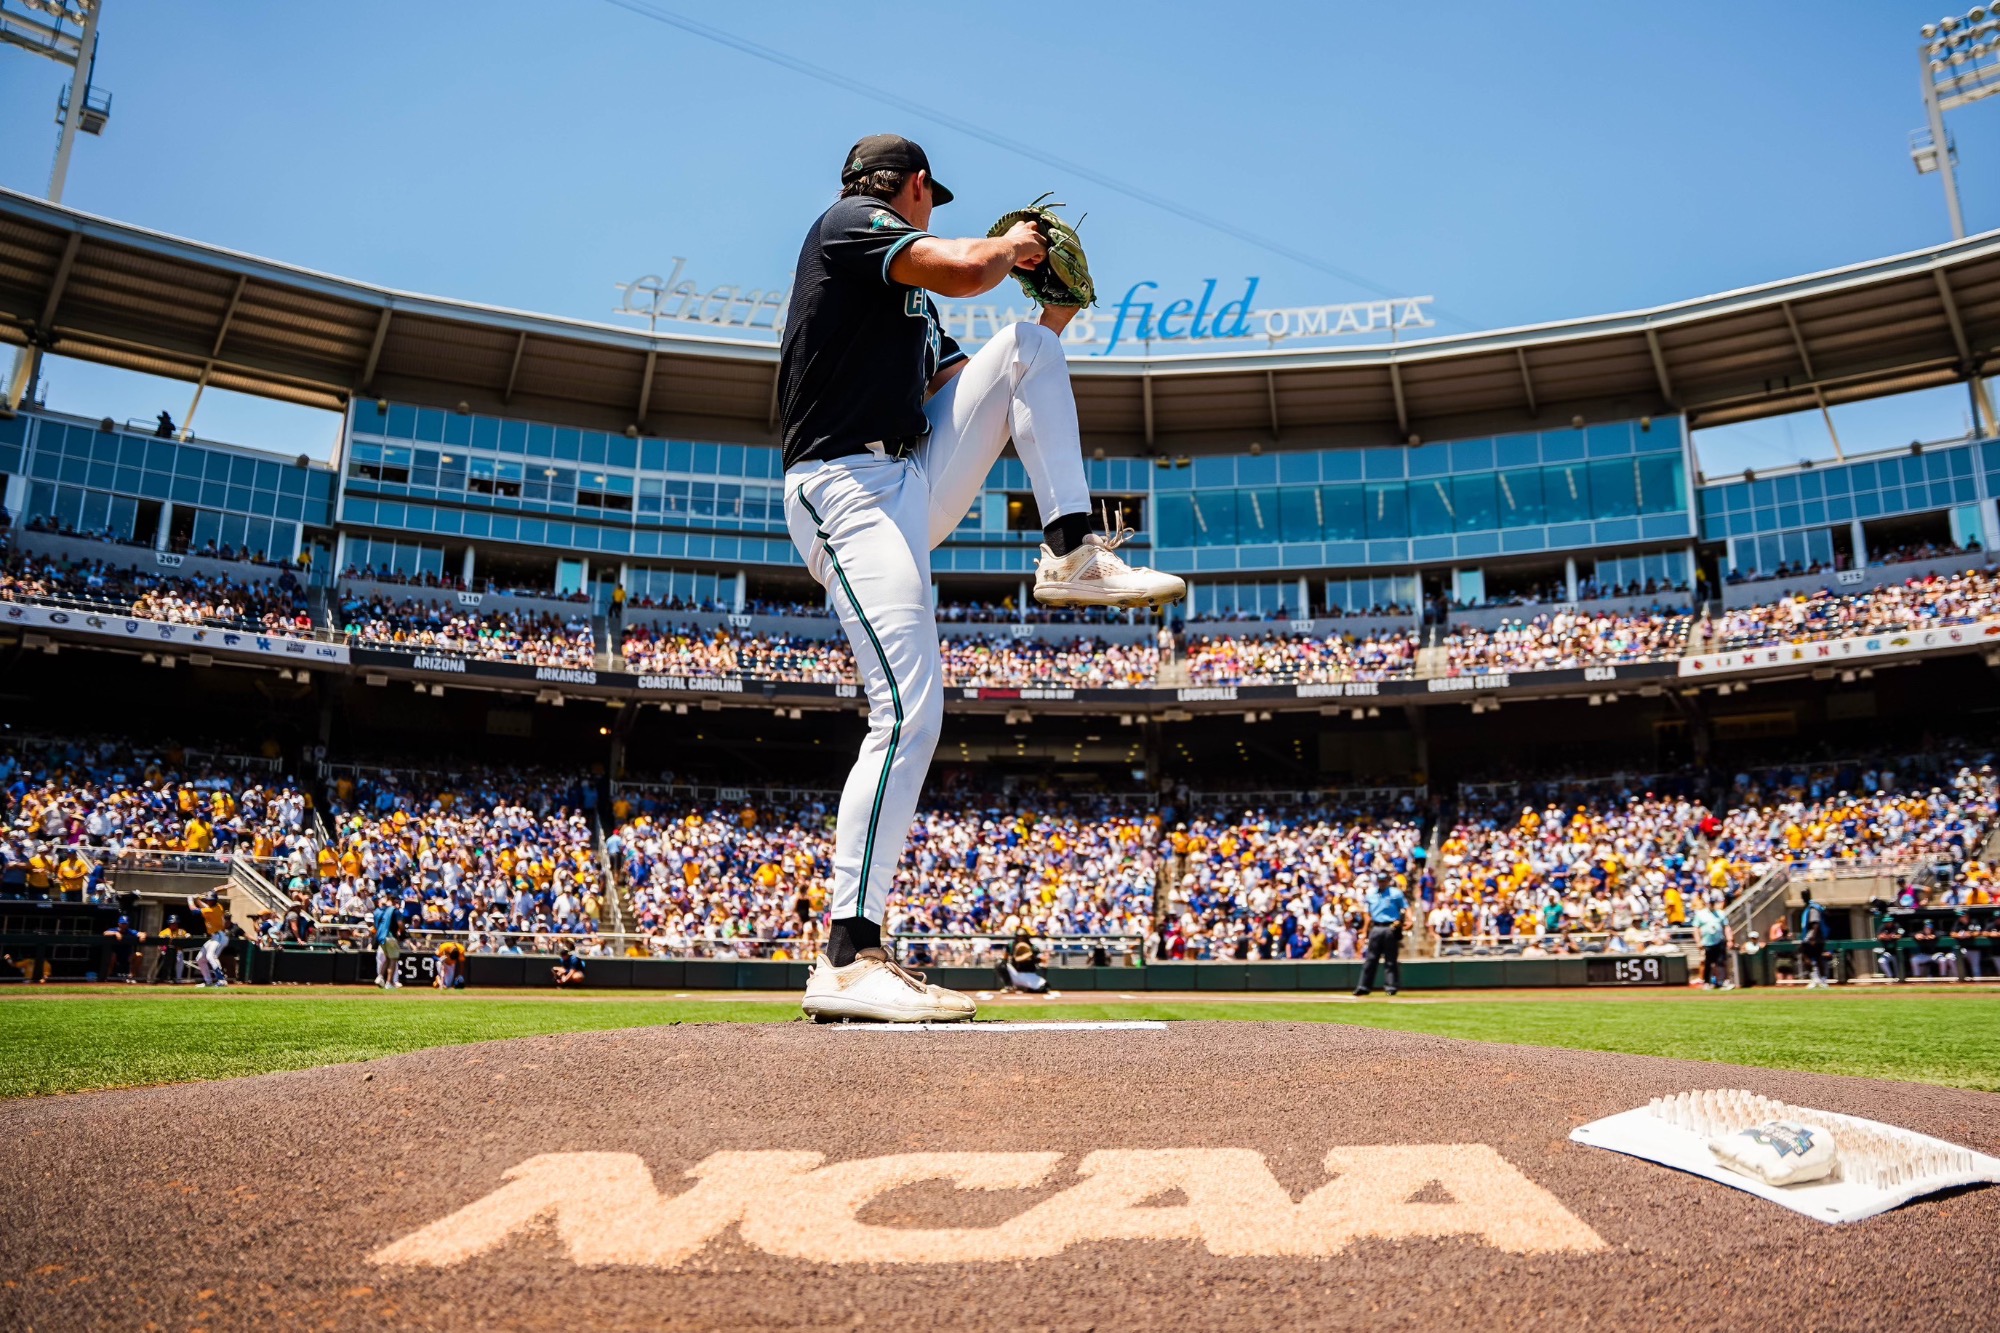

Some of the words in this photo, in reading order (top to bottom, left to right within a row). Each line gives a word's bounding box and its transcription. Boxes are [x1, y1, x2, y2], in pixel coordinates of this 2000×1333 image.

[1090, 277, 1259, 356] field
[1264, 302, 1427, 337] OMAHA
[158, 555, 181, 566] 209
[461, 595, 480, 604] 210
[316, 648, 337, 657] LSU
[413, 655, 466, 673] ARIZONA
[536, 667, 597, 685] ARKANSAS
[1584, 666, 1617, 681] UCLA
[638, 676, 686, 690] COASTAL
[688, 677, 743, 693] CAROLINA
[835, 684, 858, 698] LSU
[1296, 684, 1343, 698] MURRAY
[1345, 682, 1380, 696] STATE
[1428, 676, 1474, 692] OREGON
[1475, 674, 1510, 689] STATE
[1177, 687, 1238, 701] LOUISVILLE
[398, 956, 434, 979] :59
[1615, 958, 1659, 981] 1:59
[366, 1143, 1609, 1267] NCAA
